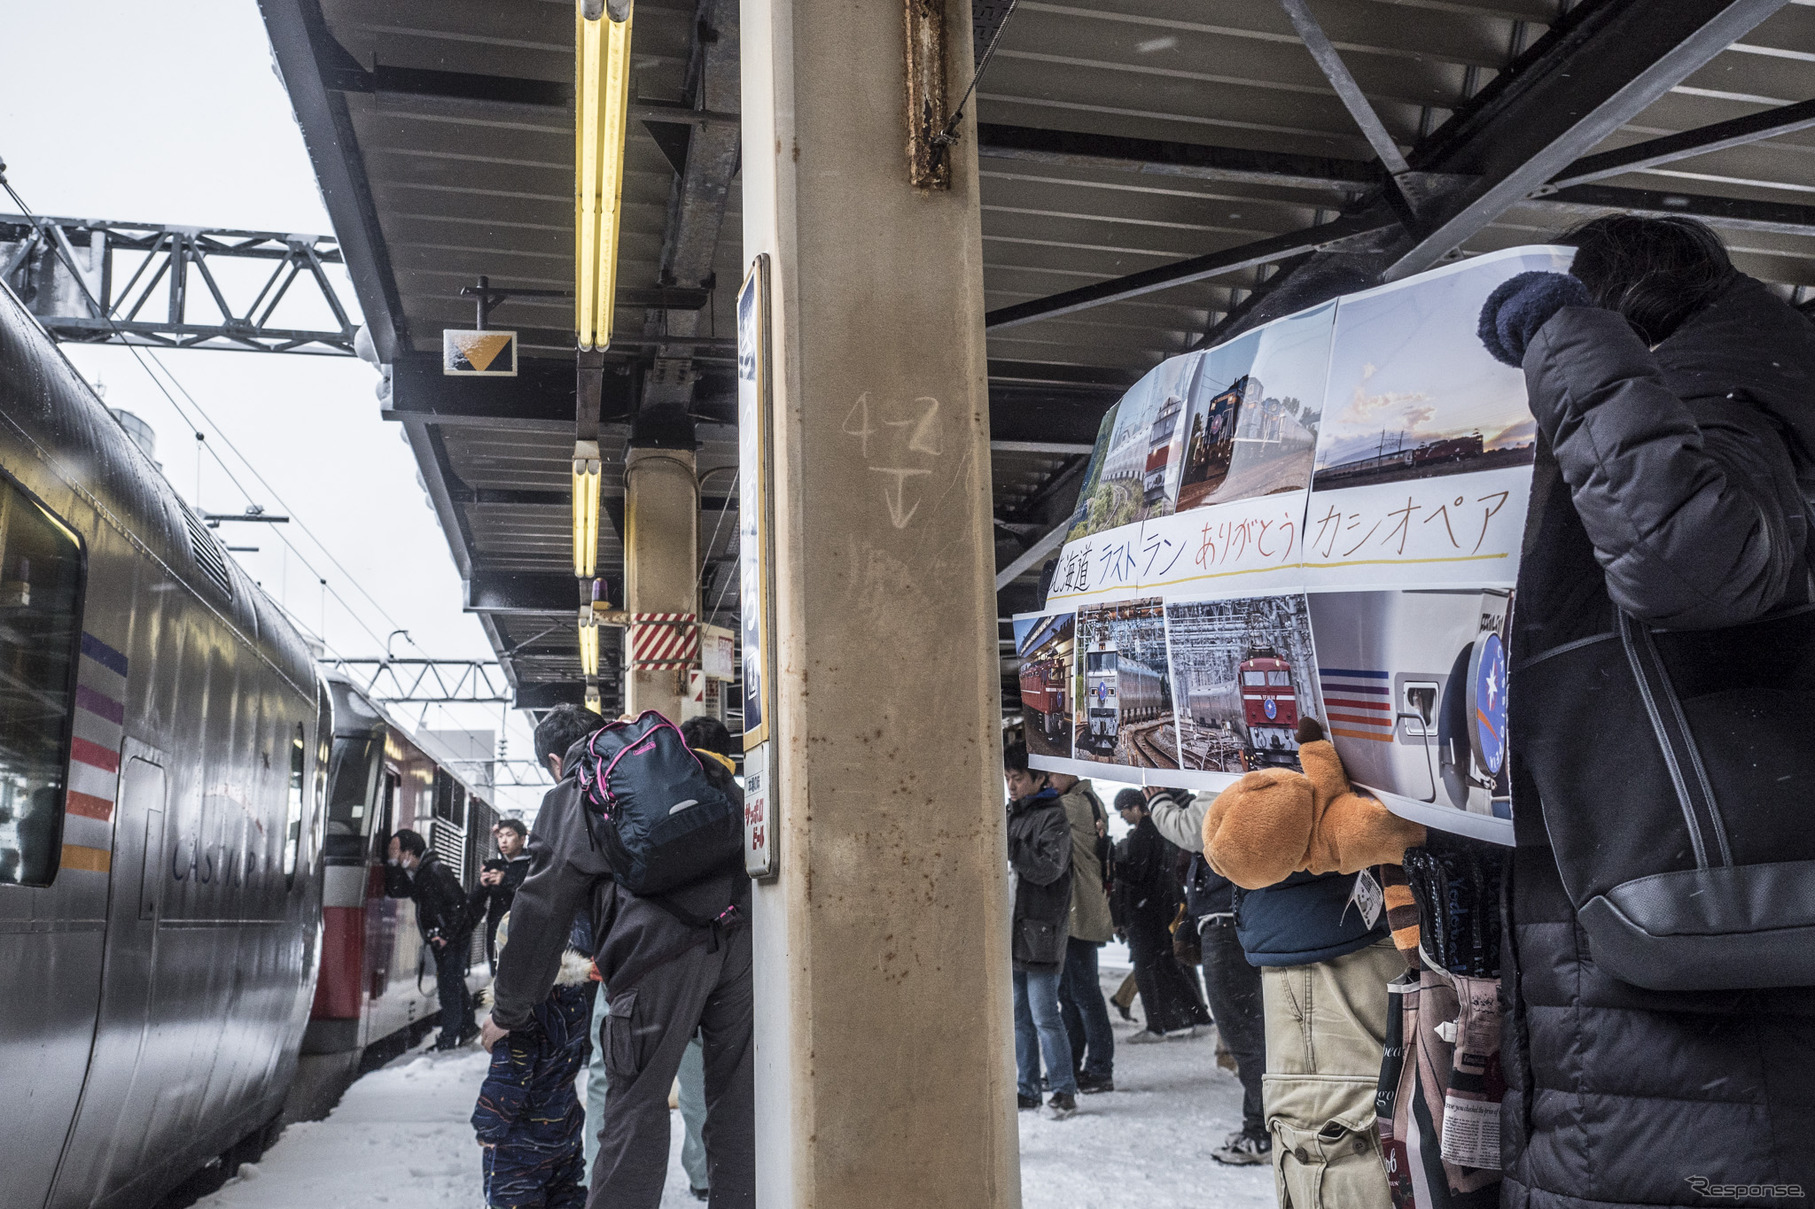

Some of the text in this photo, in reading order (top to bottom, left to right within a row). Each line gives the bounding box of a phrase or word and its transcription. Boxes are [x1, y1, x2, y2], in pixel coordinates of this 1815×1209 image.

[1195, 512, 1294, 570] ありがとう
[1312, 490, 1509, 558] カシオペア
